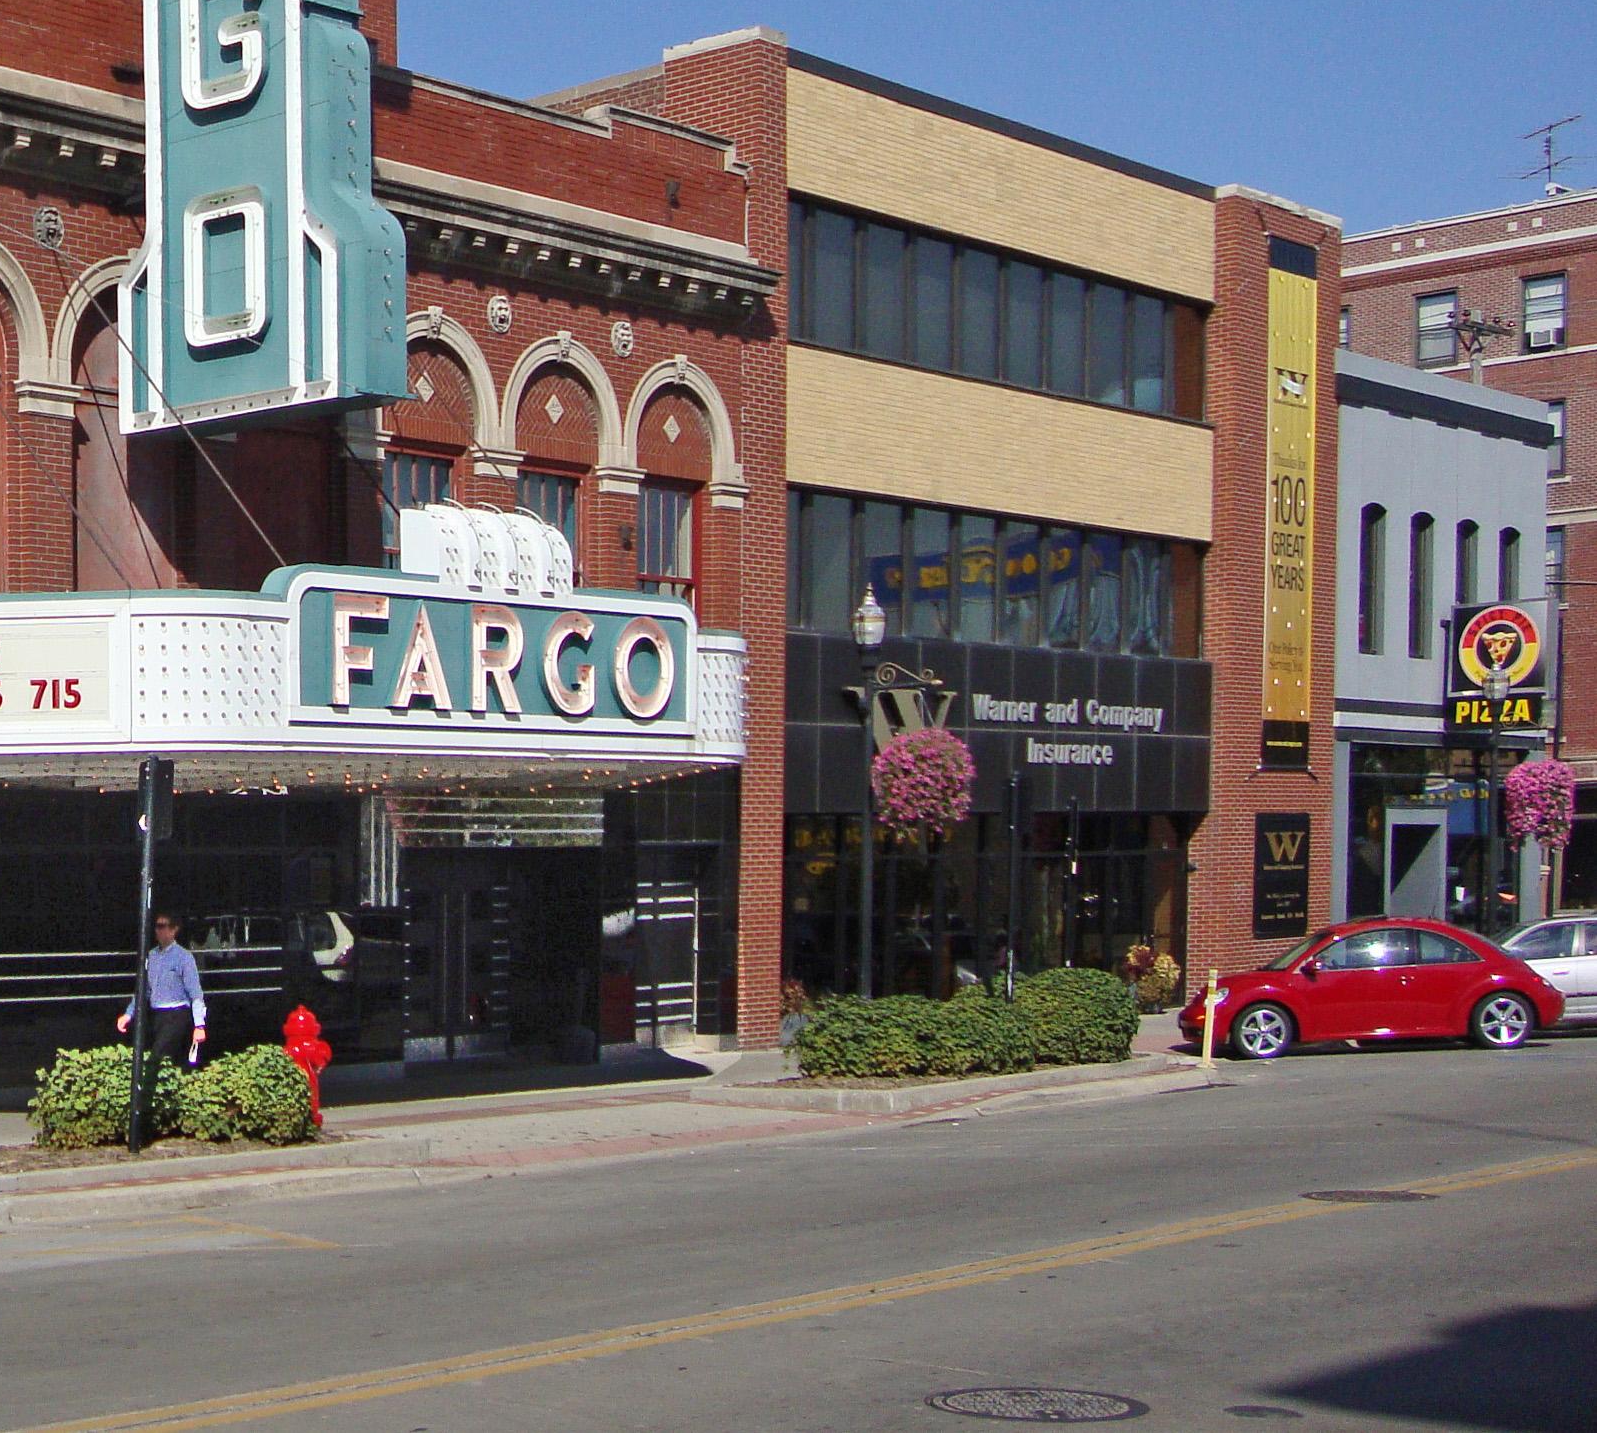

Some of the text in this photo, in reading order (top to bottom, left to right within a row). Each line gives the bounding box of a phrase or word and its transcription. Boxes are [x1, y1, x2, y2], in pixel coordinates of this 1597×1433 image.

[1271, 473, 1306, 527] 100
[1271, 531, 1305, 558] GREAT
[1271, 563, 1305, 592] YEARS
[332, 593, 675, 718] FARGO
[30, 679, 83, 710] 715
[972, 693, 1163, 733] Warner and Company
[1455, 698, 1531, 724] PIZZA
[1027, 737, 1114, 766] Insurance
[1264, 832, 1305, 862] W
